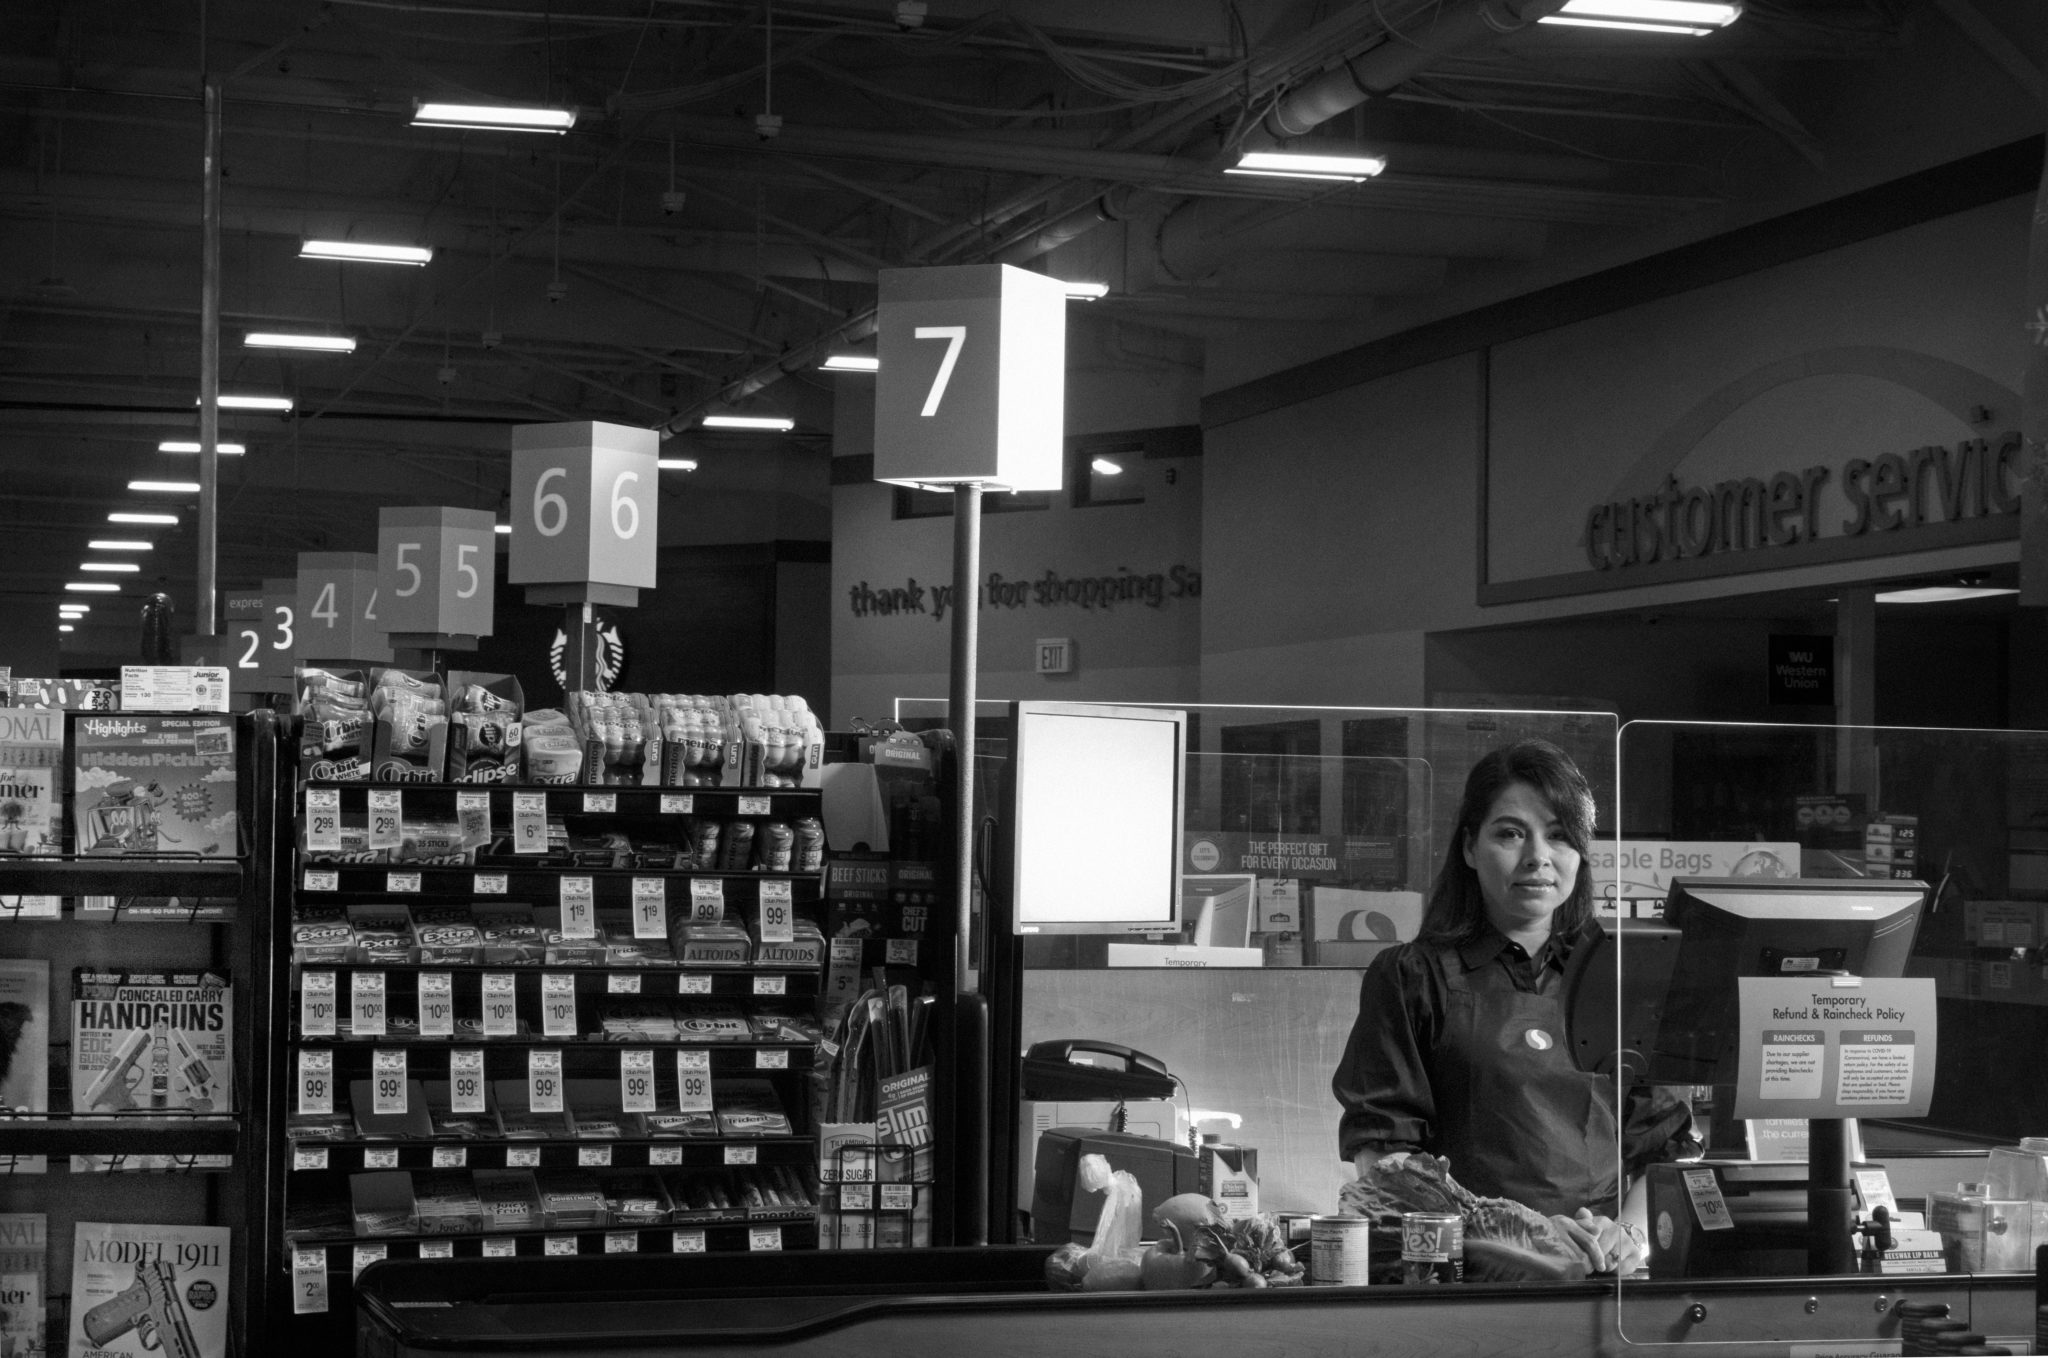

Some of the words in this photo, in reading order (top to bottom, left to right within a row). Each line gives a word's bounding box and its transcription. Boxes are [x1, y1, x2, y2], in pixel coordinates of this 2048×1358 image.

[915, 326, 966, 416] 7
[533, 467, 568, 537] 6
[611, 470, 639, 540] 6
[1585, 465, 1831, 571] customer
[396, 543, 421, 597] 5
[457, 545, 479, 598] 5
[850, 578, 925, 618] thank
[931, 585, 982, 622] yo
[987, 572, 1029, 609] for
[1034, 566, 1164, 611] shopping
[311, 582, 338, 628] 4
[273, 606, 294, 650] 3
[238, 630, 260, 668] 2
[1042, 645, 1063, 670] EXIT
[1788, 650, 1814, 664] WU
[1775, 664, 1827, 678] Western
[1784, 677, 1820, 689] Union
[84, 719, 147, 737] Highlights
[323, 718, 362, 743] Orbit
[508, 728, 519, 738] 60
[677, 736, 723, 751] mentos
[651, 742, 659, 761] GUM
[730, 744, 738, 764] GUM
[885, 749, 921, 760] ORIGINAL
[82, 752, 151, 766] Hidden
[152, 751, 231, 767] Pictures
[589, 742, 599, 784] mentos
[669, 744, 680, 785] mentos
[309, 757, 360, 780] Orbit
[335, 769, 361, 781] WHITE
[376, 759, 437, 783] Orbit
[0, 771, 15, 783] for
[1898, 829, 1915, 838] 125
[427, 840, 449, 848] STICKS
[1249, 841, 1267, 855] THE
[1268, 842, 1308, 856] PERFECT
[1309, 842, 1328, 856] GIFT
[1241, 855, 1259, 869] FOR
[1261, 855, 1290, 870] EVERY
[1292, 856, 1336, 870] OCCASION
[1660, 848, 1712, 874] Bags
[832, 868, 854, 883] BEEF
[856, 868, 887, 884] STICKS
[898, 869, 934, 880] ORIGINAL
[1894, 869, 1912, 879] 336
[843, 890, 874, 899] ORIGINAL
[902, 906, 928, 916] CHEF'S
[901, 916, 928, 932] CUT
[423, 929, 474, 943] Extra
[689, 949, 740, 961] ALTOIDS
[763, 948, 814, 961] ALTOIDS
[1164, 957, 1207, 968] Temporary
[119, 989, 183, 1002] CONCEALED
[186, 990, 224, 1002] CARRY
[1811, 994, 1866, 1008] Temporary
[80, 1002, 224, 1031] HANDGUNS
[1772, 1008, 1808, 1020] Refund
[1811, 1008, 1820, 1020] &
[1822, 1008, 1873, 1020] Raincheck
[1876, 1008, 1905, 1023] Policy
[683, 1018, 739, 1032] Orbit
[1773, 1034, 1816, 1042] RAINCHECKS
[1863, 1034, 1893, 1042] REFUNDS
[80, 1038, 112, 1053] EDC
[80, 1053, 111, 1064] GUNS
[881, 1072, 930, 1094] ORIGINAL
[653, 1115, 694, 1125] Trident
[727, 1115, 768, 1124] Trident
[1762, 1130, 1779, 1139] the
[831, 1139, 868, 1149] TILLAMOOK
[823, 1169, 844, 1181] ZERO
[845, 1169, 873, 1181] SUGAR
[623, 1203, 657, 1212] ICE
[751, 1209, 817, 1221] mentos
[1402, 1224, 1444, 1253] Yes!
[83, 1239, 163, 1264] MODEL
[176, 1243, 222, 1272] 1911
[1884, 1250, 1912, 1260] BEESWAX
[1912, 1250, 1921, 1259] LIP
[1923, 1250, 1939, 1259] BALM
[82, 1350, 134, 1358] AMERICAN
